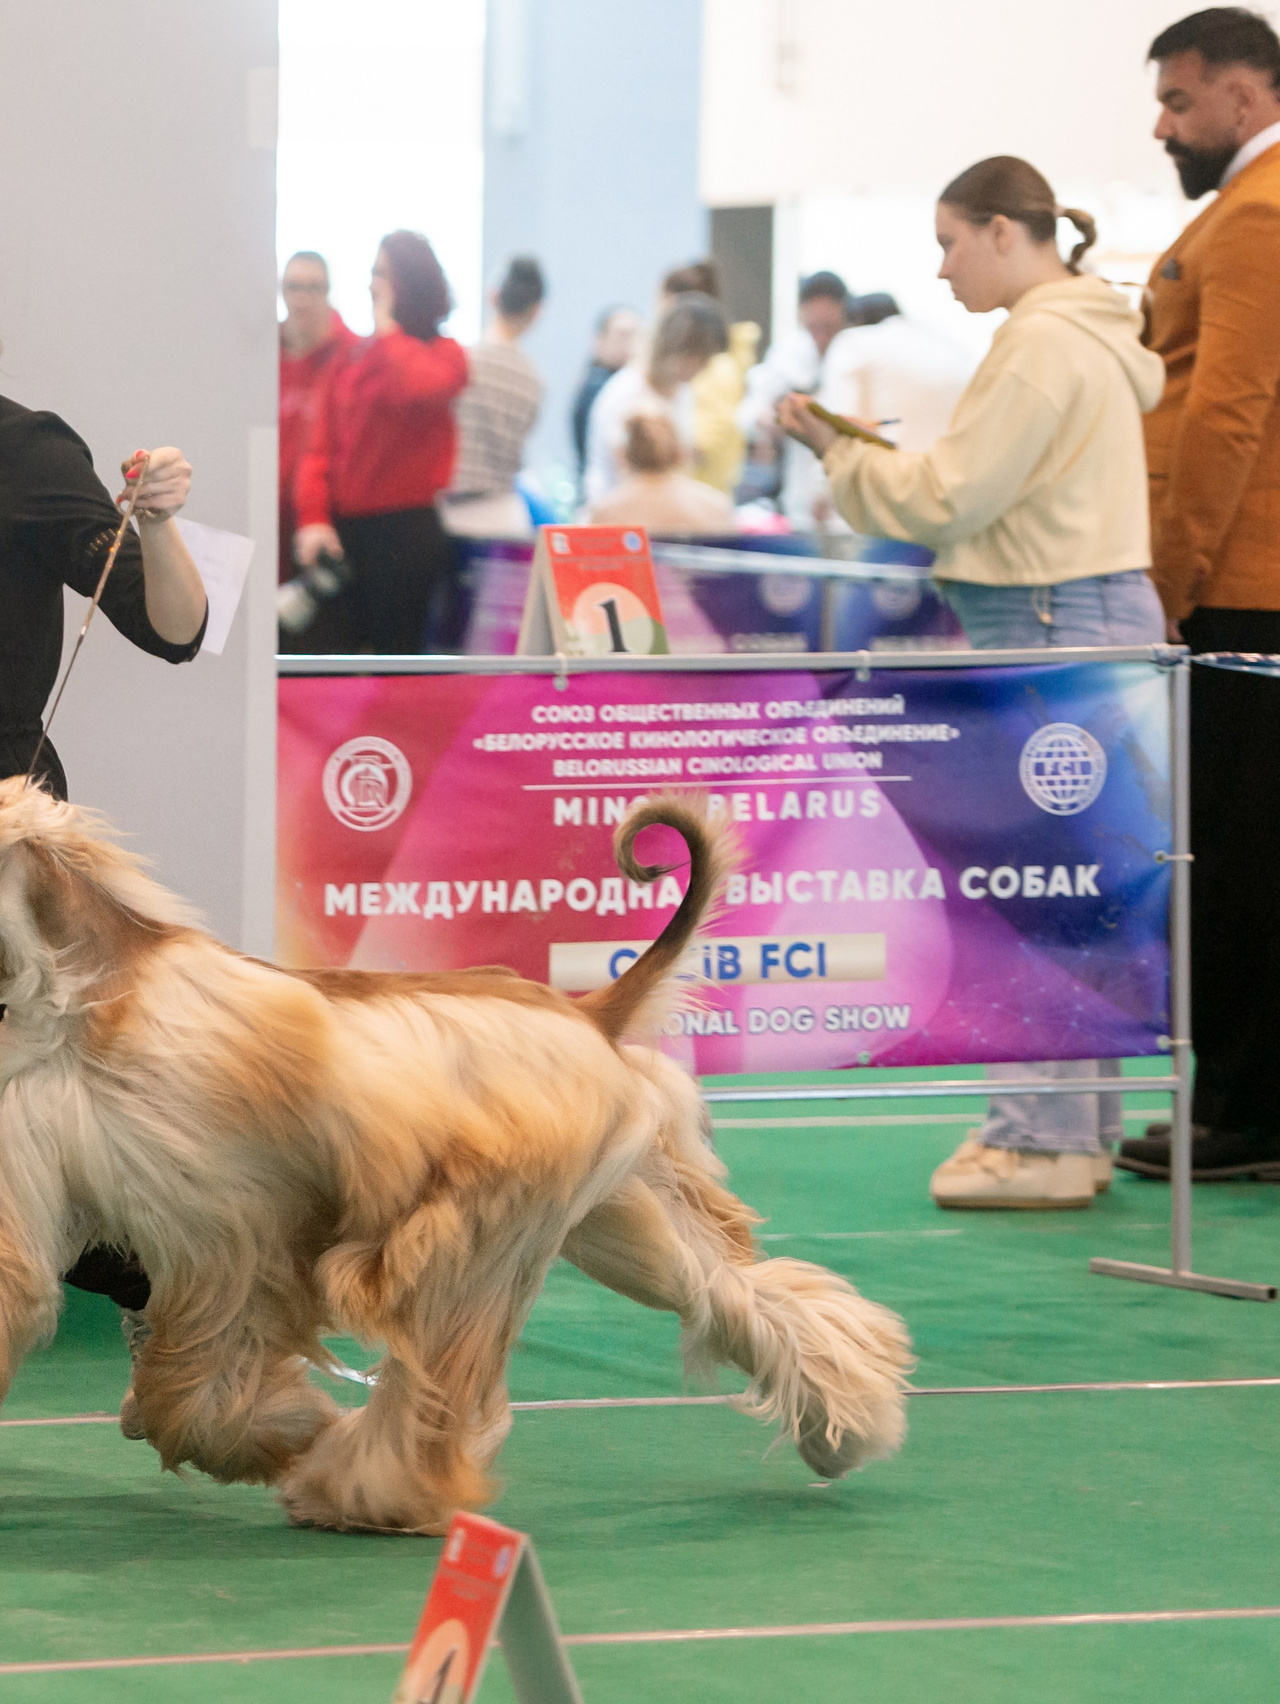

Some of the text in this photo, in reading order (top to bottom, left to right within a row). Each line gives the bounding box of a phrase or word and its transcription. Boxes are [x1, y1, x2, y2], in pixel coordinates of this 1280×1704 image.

[600, 598, 631, 652] 1
[531, 693, 905, 726] СОЮЗ ОБЩЕСТВЕННЫХ ОБЪЕДИНЕНИЙ
[629, 727, 808, 750] КИНОЛОГИЧЕСКОЕ
[553, 751, 883, 778] BELORUSSIAN CINOLOGICAL UNION
[553, 795, 650, 827] MIN
[324, 863, 1101, 919] МЕЖДУНАРОДНА ВЫСТАВКА СОБАК
[760, 942, 826, 979] FCI
[748, 1005, 815, 1034] DOG
[825, 1003, 911, 1032] SHOW
